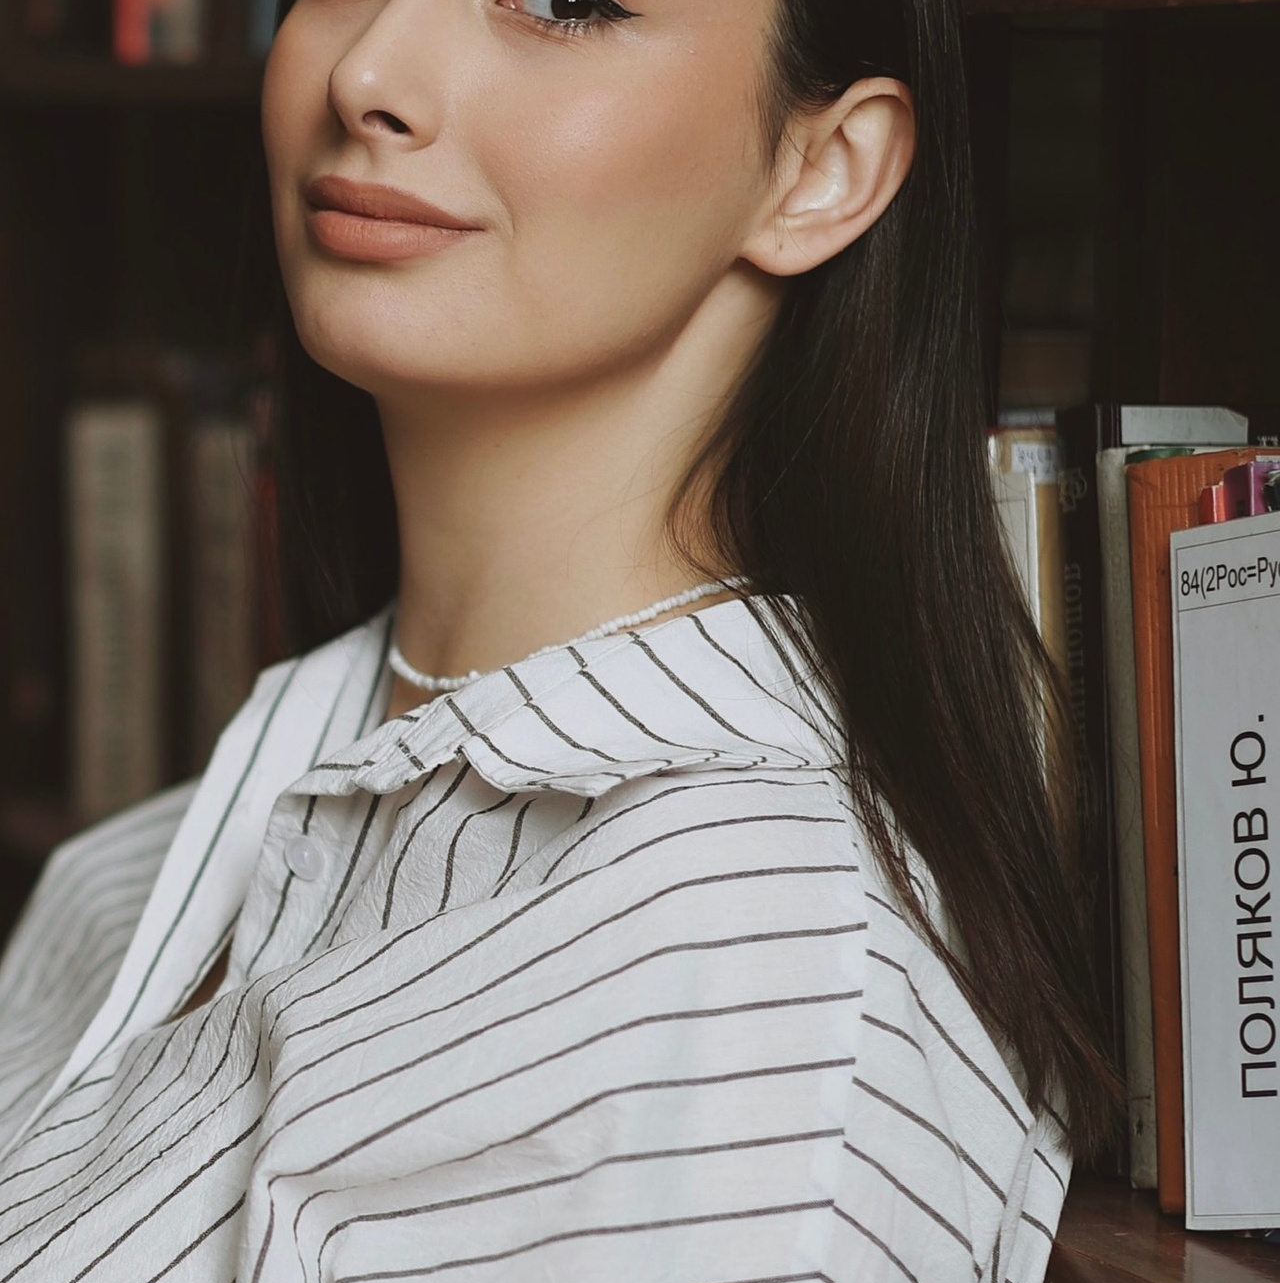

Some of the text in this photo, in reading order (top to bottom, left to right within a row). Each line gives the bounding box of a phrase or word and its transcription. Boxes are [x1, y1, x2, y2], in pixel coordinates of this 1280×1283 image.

[1181, 556, 1280, 599] 84(2Рос=Ру
[1230, 714, 1277, 1099] ПОЛЯКОВ Ю.
